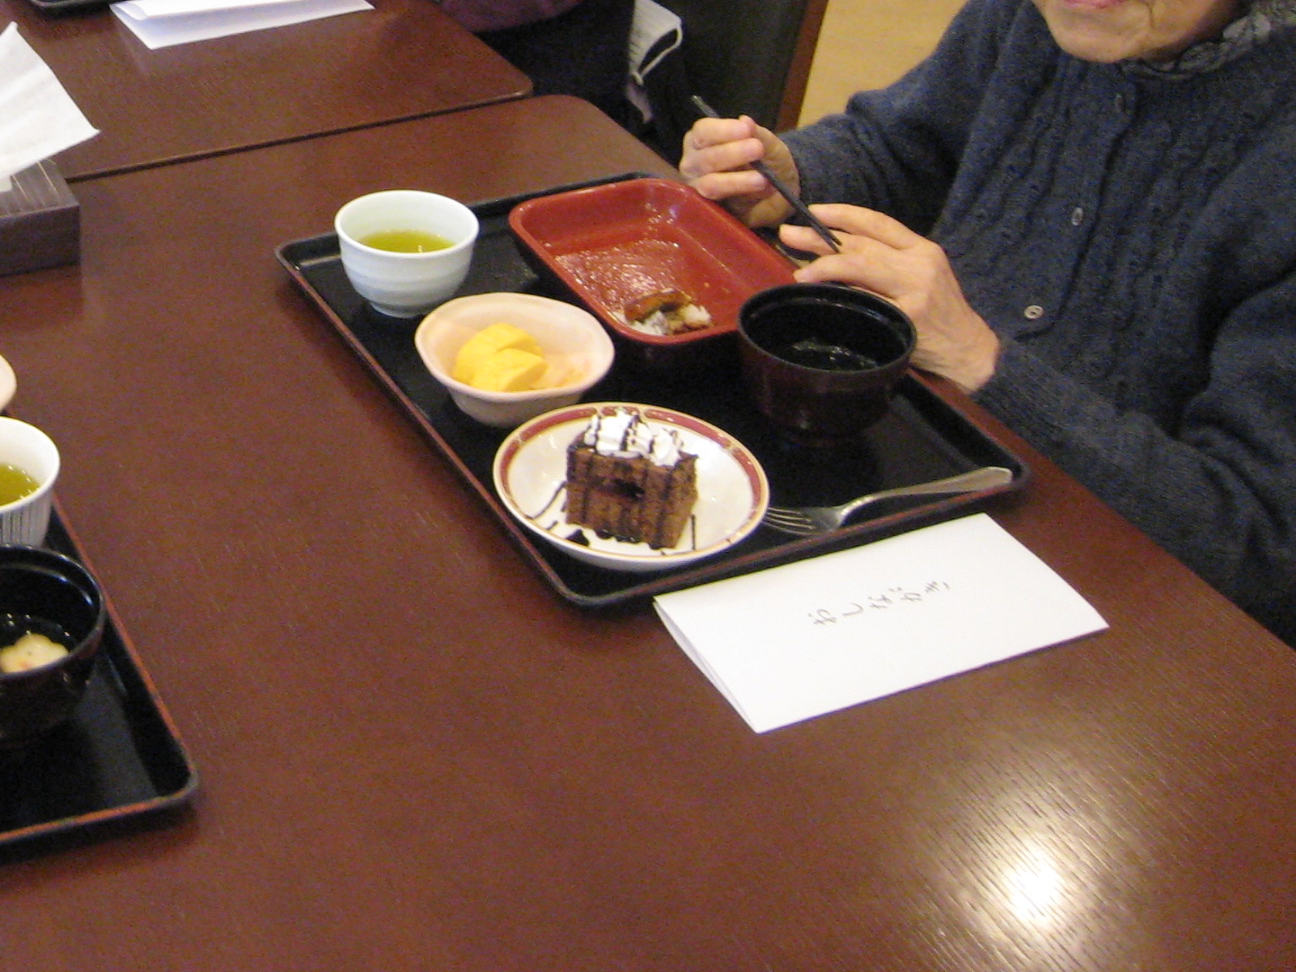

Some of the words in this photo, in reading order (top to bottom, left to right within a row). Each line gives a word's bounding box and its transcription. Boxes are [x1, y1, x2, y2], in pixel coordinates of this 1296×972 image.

[807, 580, 950, 625] おしながき
